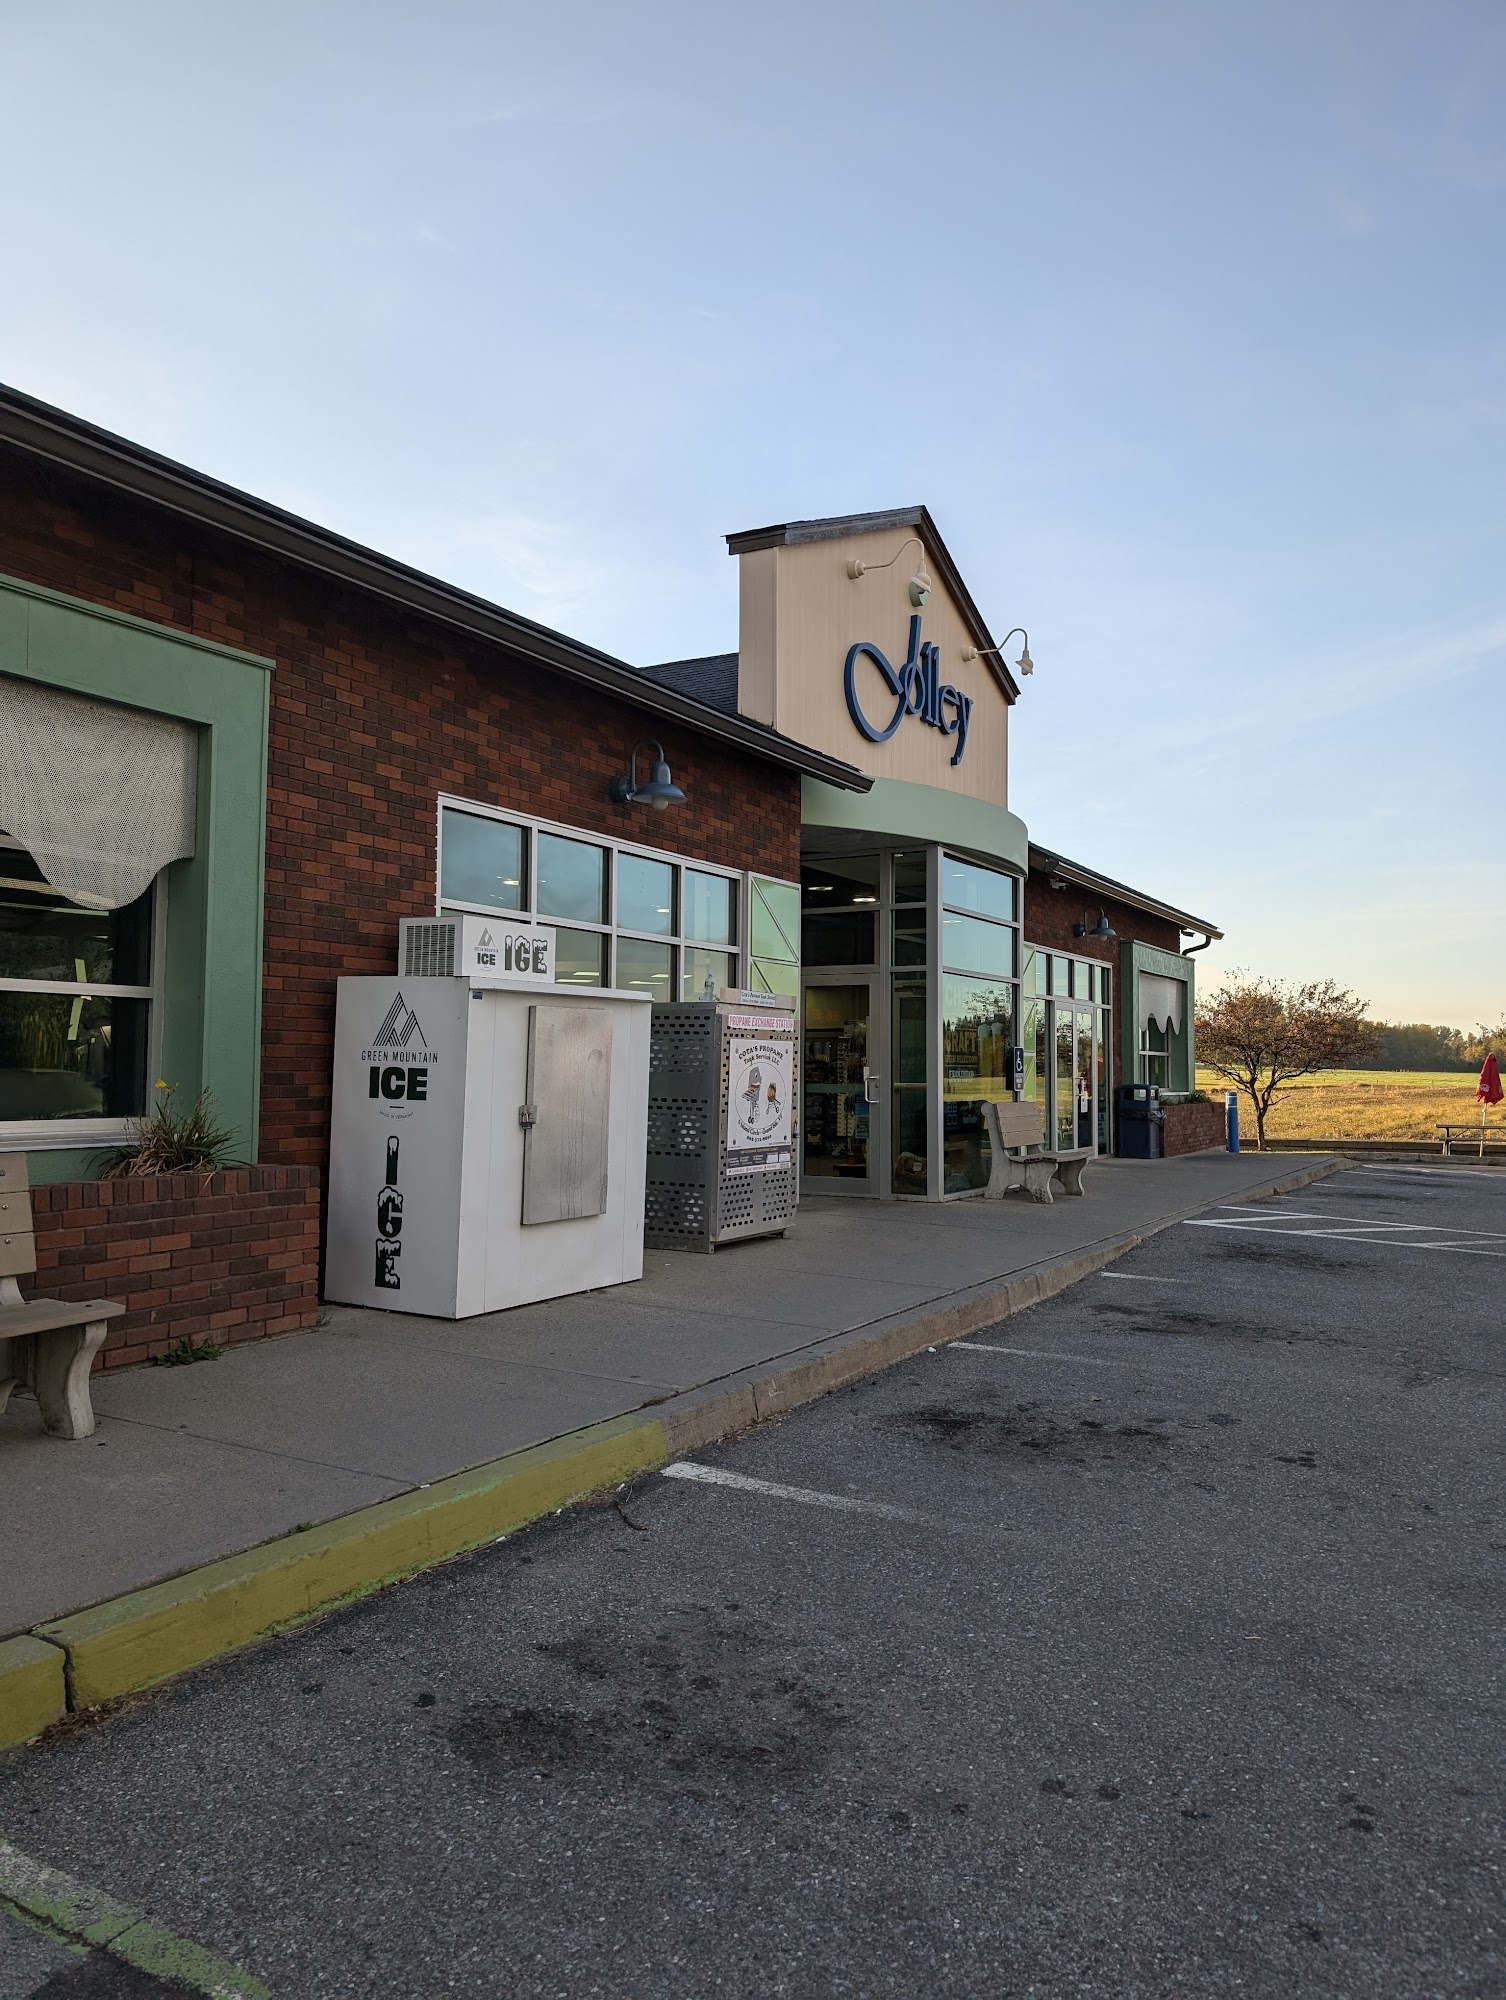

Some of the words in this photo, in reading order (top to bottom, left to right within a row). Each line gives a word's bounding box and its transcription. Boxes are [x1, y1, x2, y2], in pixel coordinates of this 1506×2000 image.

[843, 614, 974, 766] Jolley
[477, 952, 496, 966] ICE
[504, 935, 548, 974] ICE
[730, 1016, 751, 1027] PROPANE
[752, 1017, 775, 1028] EXCHANGE
[776, 1018, 794, 1029] STATION
[361, 1050, 388, 1061] GREEN
[393, 1051, 438, 1063] MOUNTAIN
[739, 1045, 758, 1060] COTA'S
[759, 1045, 784, 1060] PROPANE
[369, 1066, 428, 1101] ICE
[374, 1135, 403, 1289] ICE
